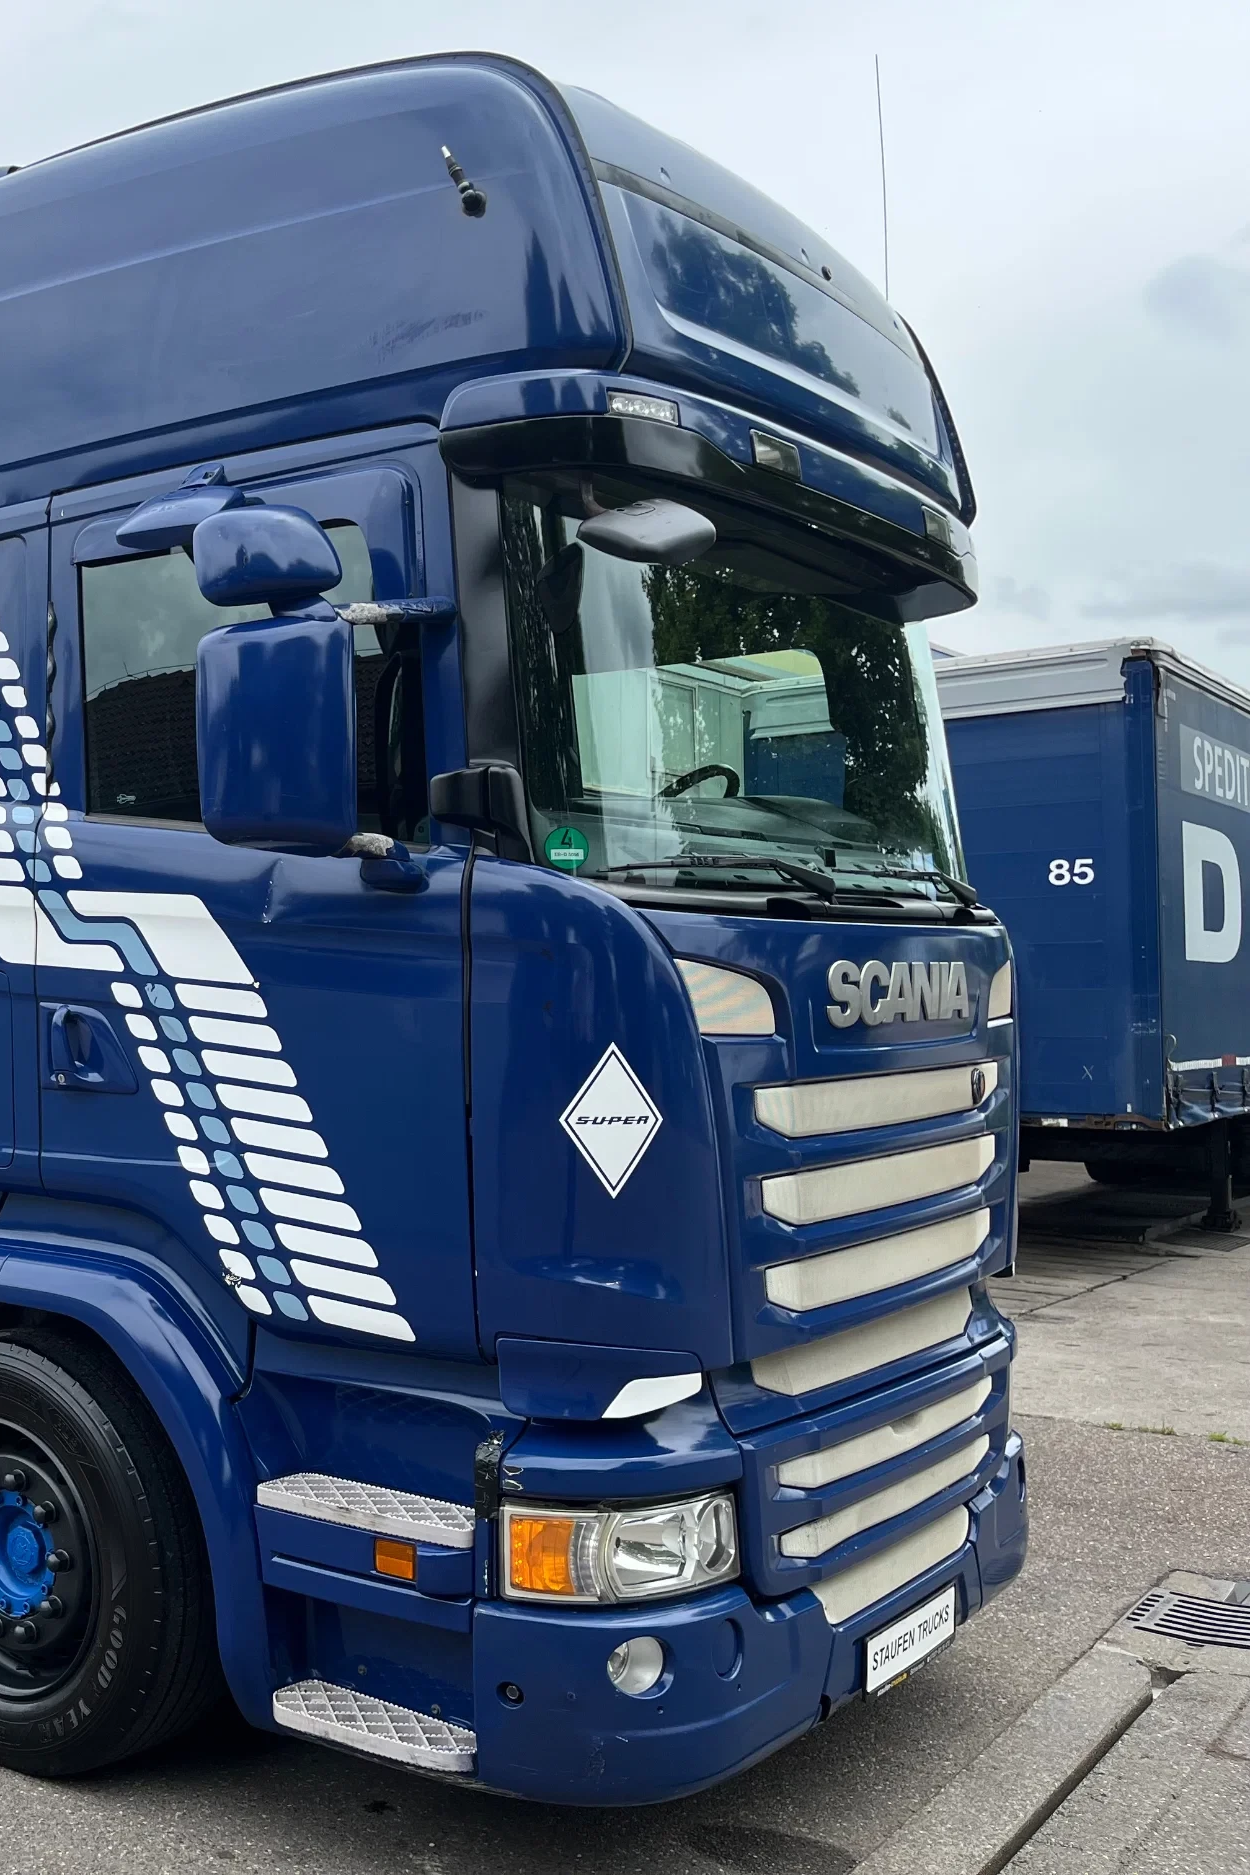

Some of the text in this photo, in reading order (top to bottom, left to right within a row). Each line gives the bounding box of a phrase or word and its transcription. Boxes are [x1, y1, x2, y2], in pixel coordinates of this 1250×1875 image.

[1193, 736, 1250, 806] SPEDIT
[561, 829, 573, 848] 4
[1048, 858, 1095, 886] 85
[1182, 820, 1242, 964] D
[827, 959, 969, 1029] SCANIA
[576, 1115, 649, 1126] SUPER
[872, 1628, 915, 1671] STAUFEN
[918, 1604, 950, 1642] TRUCKS
